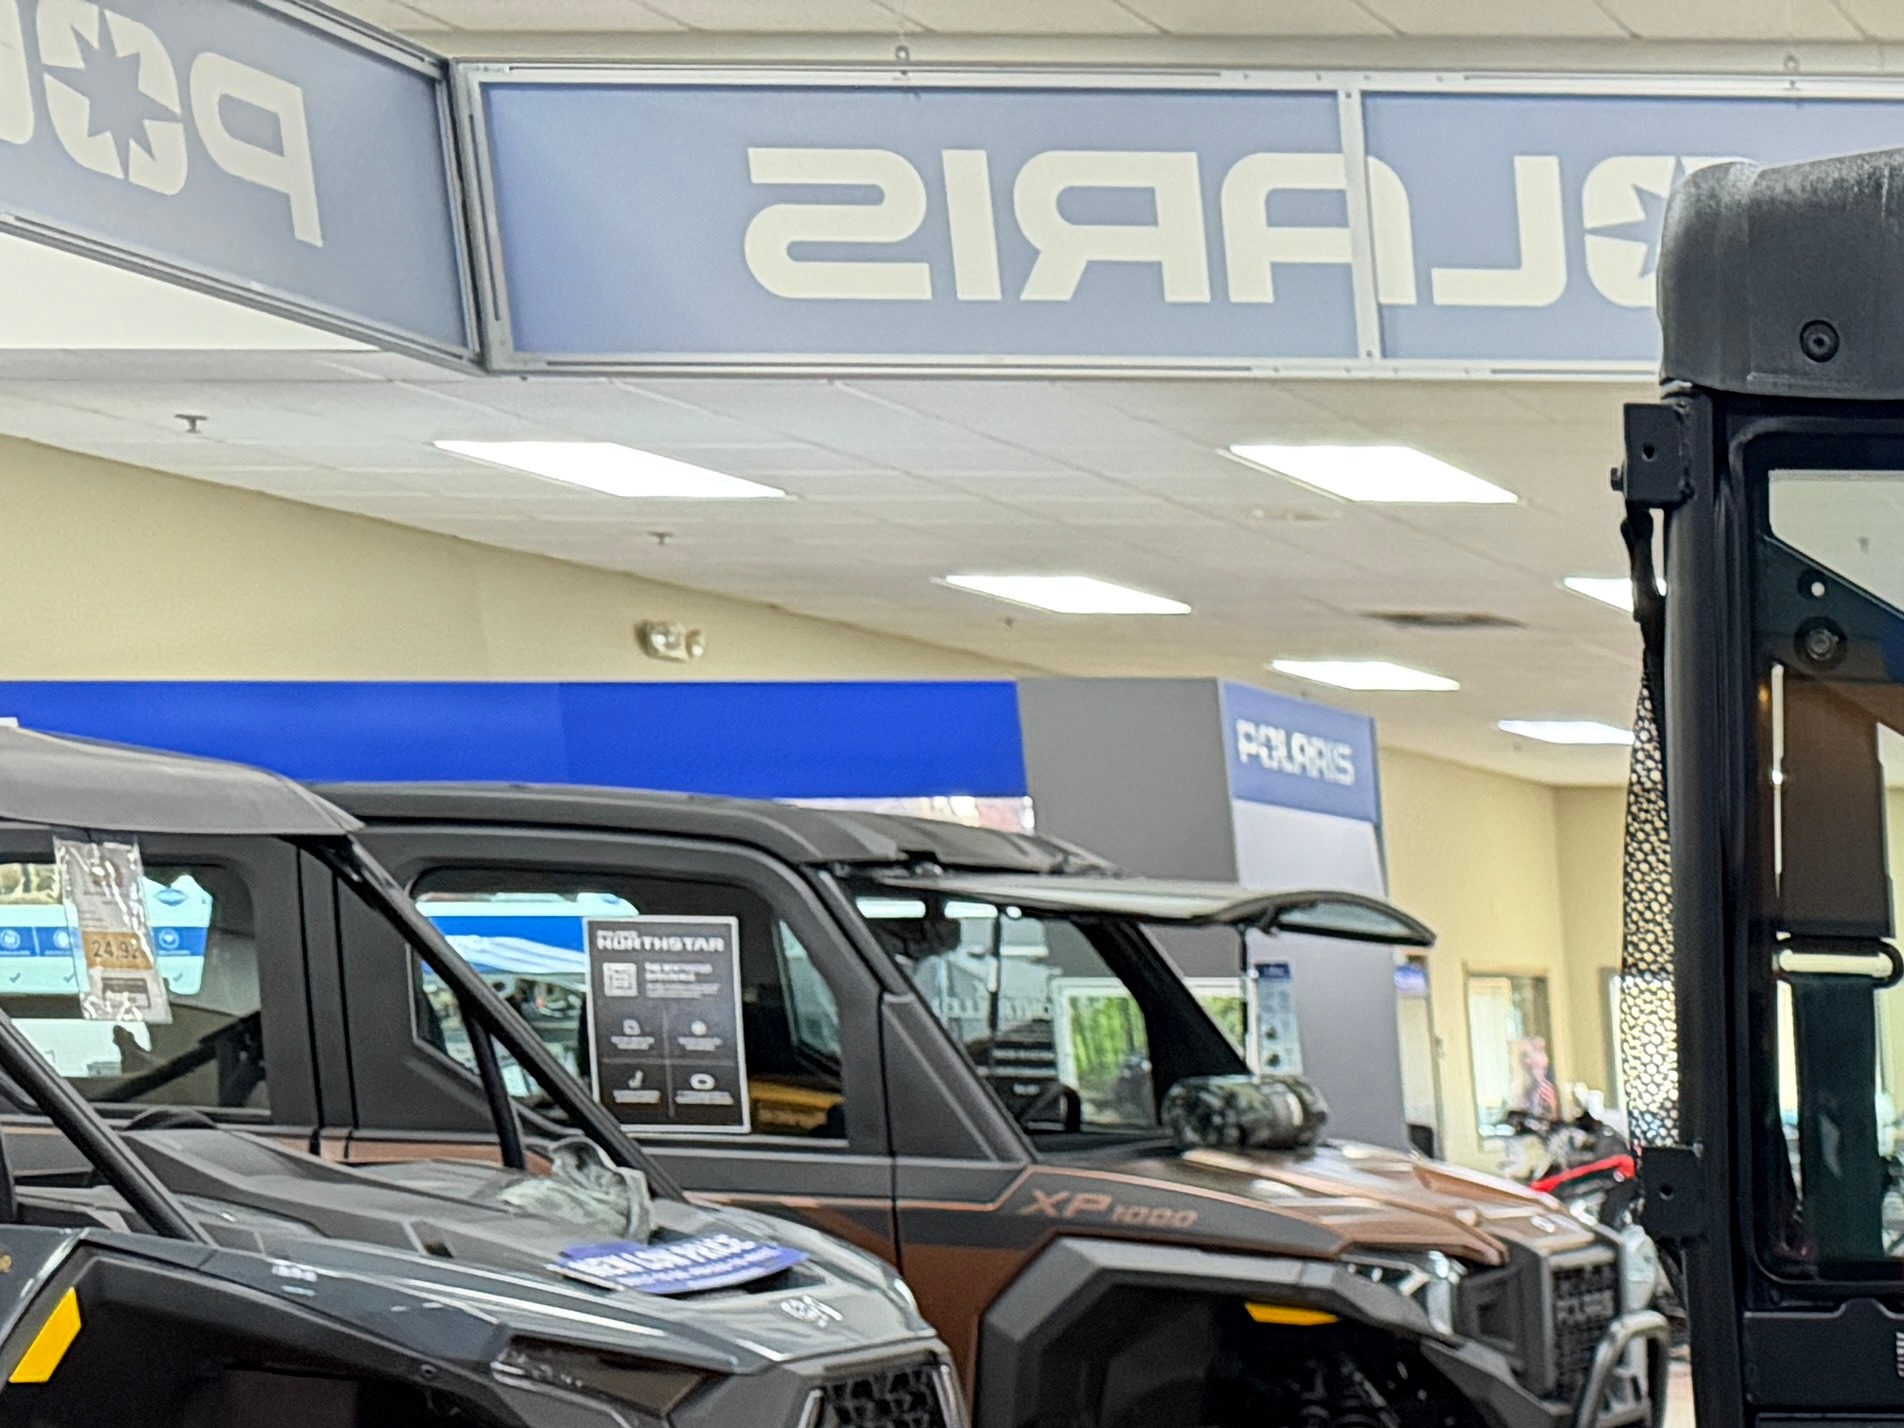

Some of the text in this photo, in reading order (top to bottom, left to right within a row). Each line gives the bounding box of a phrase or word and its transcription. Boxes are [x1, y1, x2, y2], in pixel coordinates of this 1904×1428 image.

[1236, 718, 1355, 787] POLARIS
[1017, 1189, 1199, 1228] XP 1000
